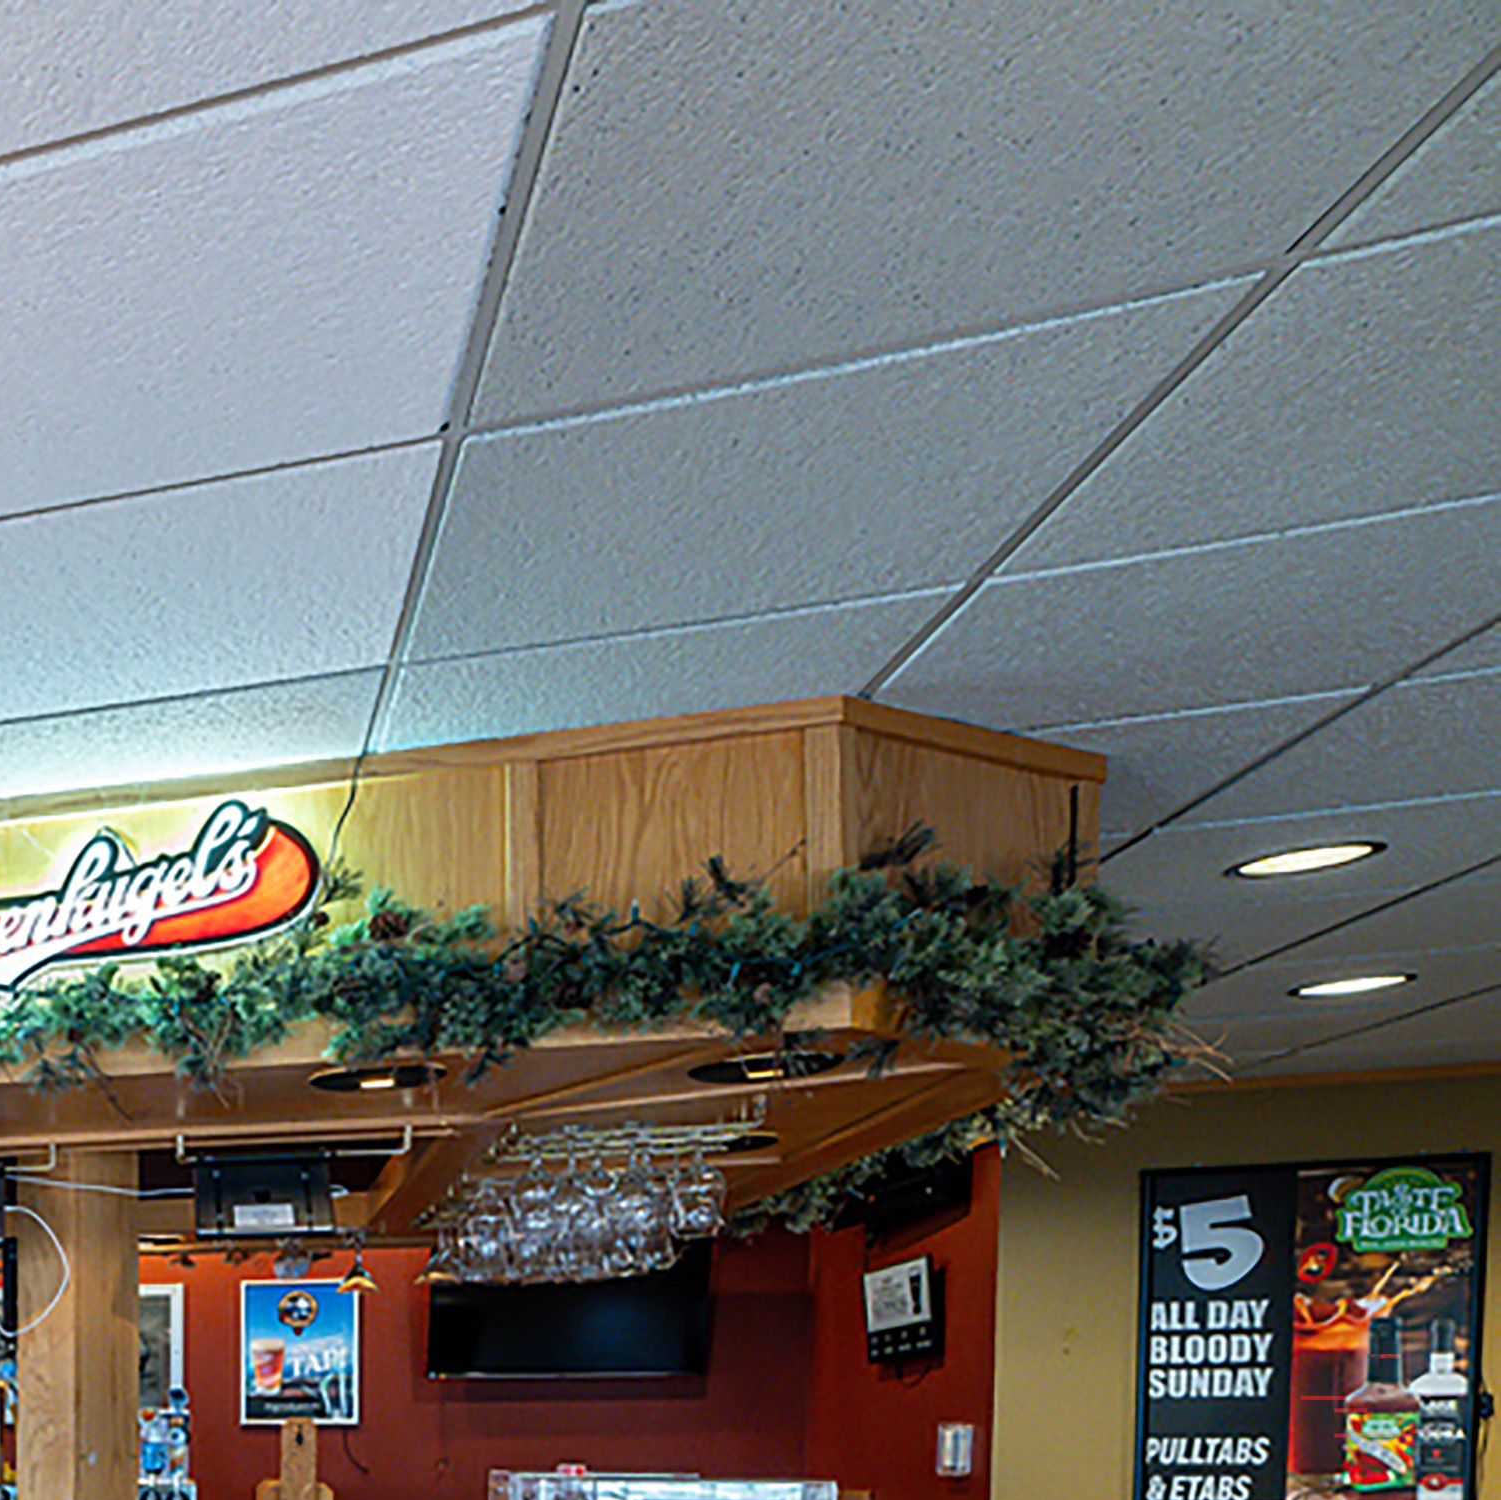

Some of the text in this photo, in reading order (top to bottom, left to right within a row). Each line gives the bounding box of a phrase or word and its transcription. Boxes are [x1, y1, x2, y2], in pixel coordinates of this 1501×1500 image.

[1344, 1208, 1464, 1238] FLORIDA
[1153, 1194, 1265, 1290] $5
[1150, 1299, 1270, 1331] ALL DAY
[1149, 1333, 1274, 1365] BLOODY
[1149, 1367, 1274, 1398] SUNDAY
[1146, 1437, 1271, 1465] PULLTABS
